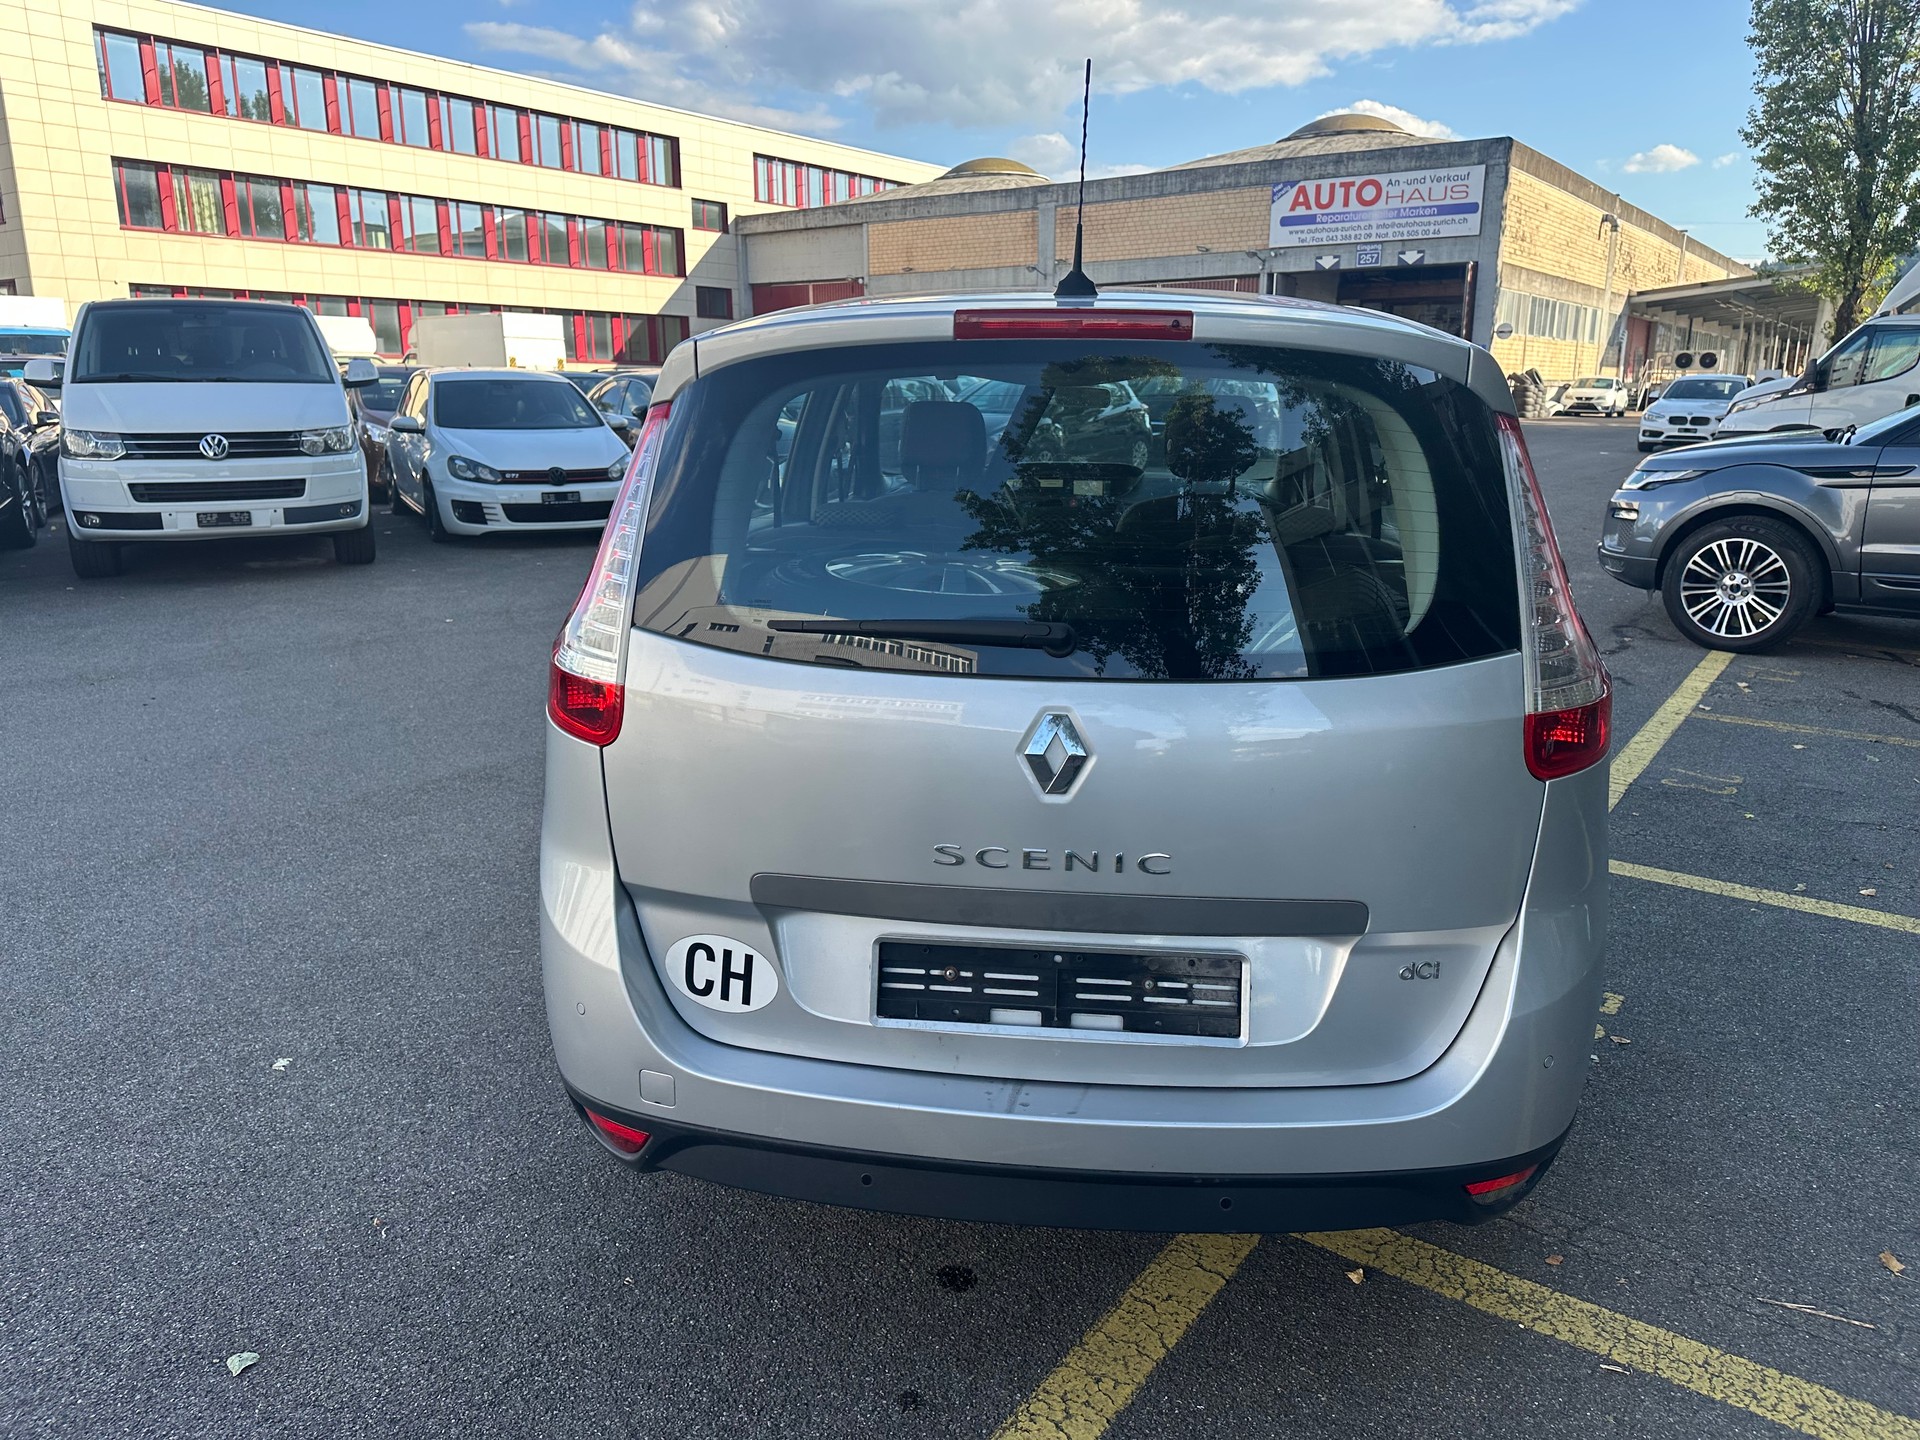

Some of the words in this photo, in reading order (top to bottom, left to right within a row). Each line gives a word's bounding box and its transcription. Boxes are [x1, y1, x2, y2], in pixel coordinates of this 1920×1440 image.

[1386, 178, 1400, 187] An
[1429, 171, 1471, 184] Verkauf
[1400, 206, 1438, 217] Marken
[1288, 223, 1373, 235] www.autohaus-zurich.ch
[1375, 217, 1469, 230] info@autohaus-zurich.ch
[1325, 235, 1338, 243] 043
[1363, 232, 1373, 240] 09
[1406, 229, 1420, 237] 505
[1356, 243, 1382, 252] Eingang
[1359, 253, 1378, 264] 257
[932, 843, 1172, 875] SCENIC
[685, 942, 754, 1006] CH
